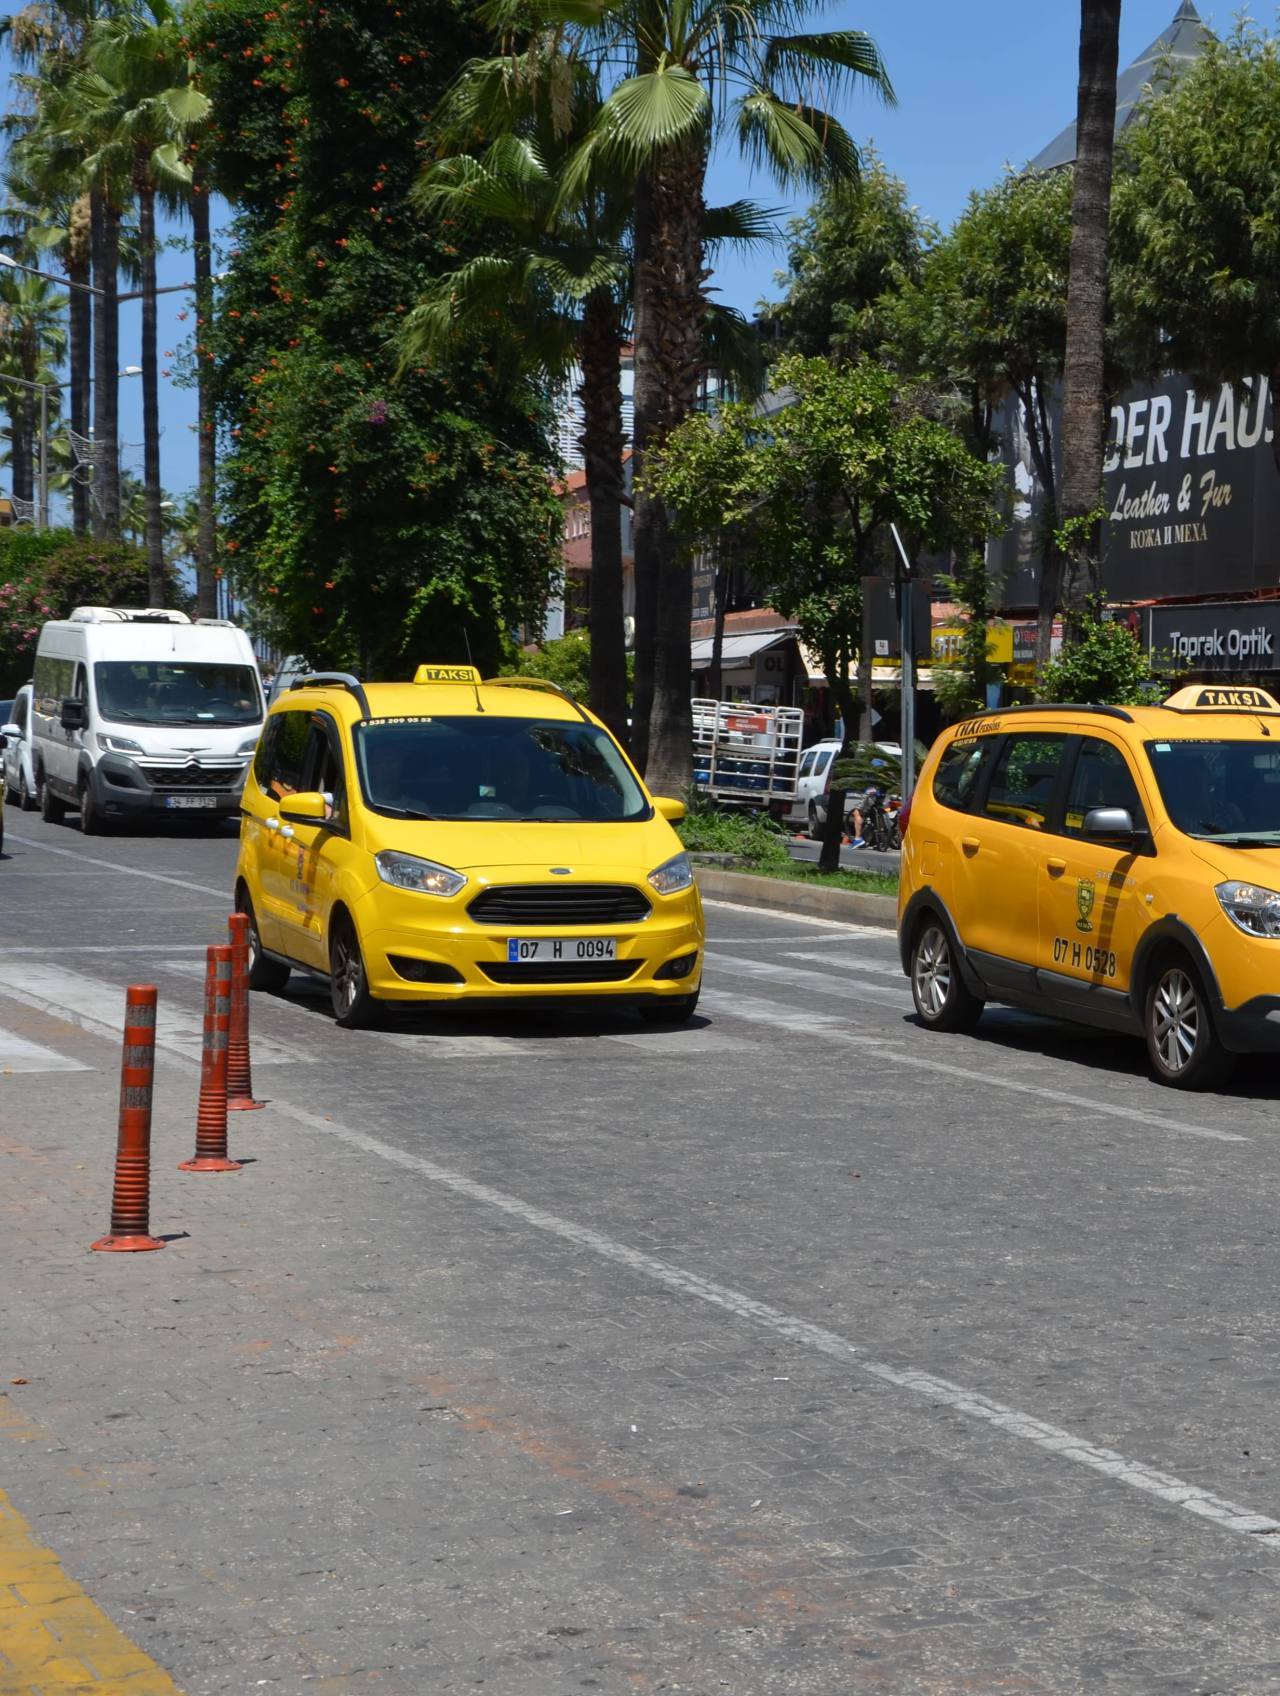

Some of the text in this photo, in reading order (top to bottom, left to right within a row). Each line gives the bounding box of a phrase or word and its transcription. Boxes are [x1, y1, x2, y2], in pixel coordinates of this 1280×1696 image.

[1102, 374, 1274, 473] DER HAU
[1109, 469, 1233, 520] Leather & Fur
[1130, 522, 1208, 549] КОЖА И МЕХА
[1169, 626, 1274, 661] Toprak Optik
[428, 669, 473, 681] TAKSİ
[1205, 691, 1260, 706] TAKSİ
[520, 940, 613, 958] 07 H 0094
[1053, 937, 1116, 977] 07 H 0528
